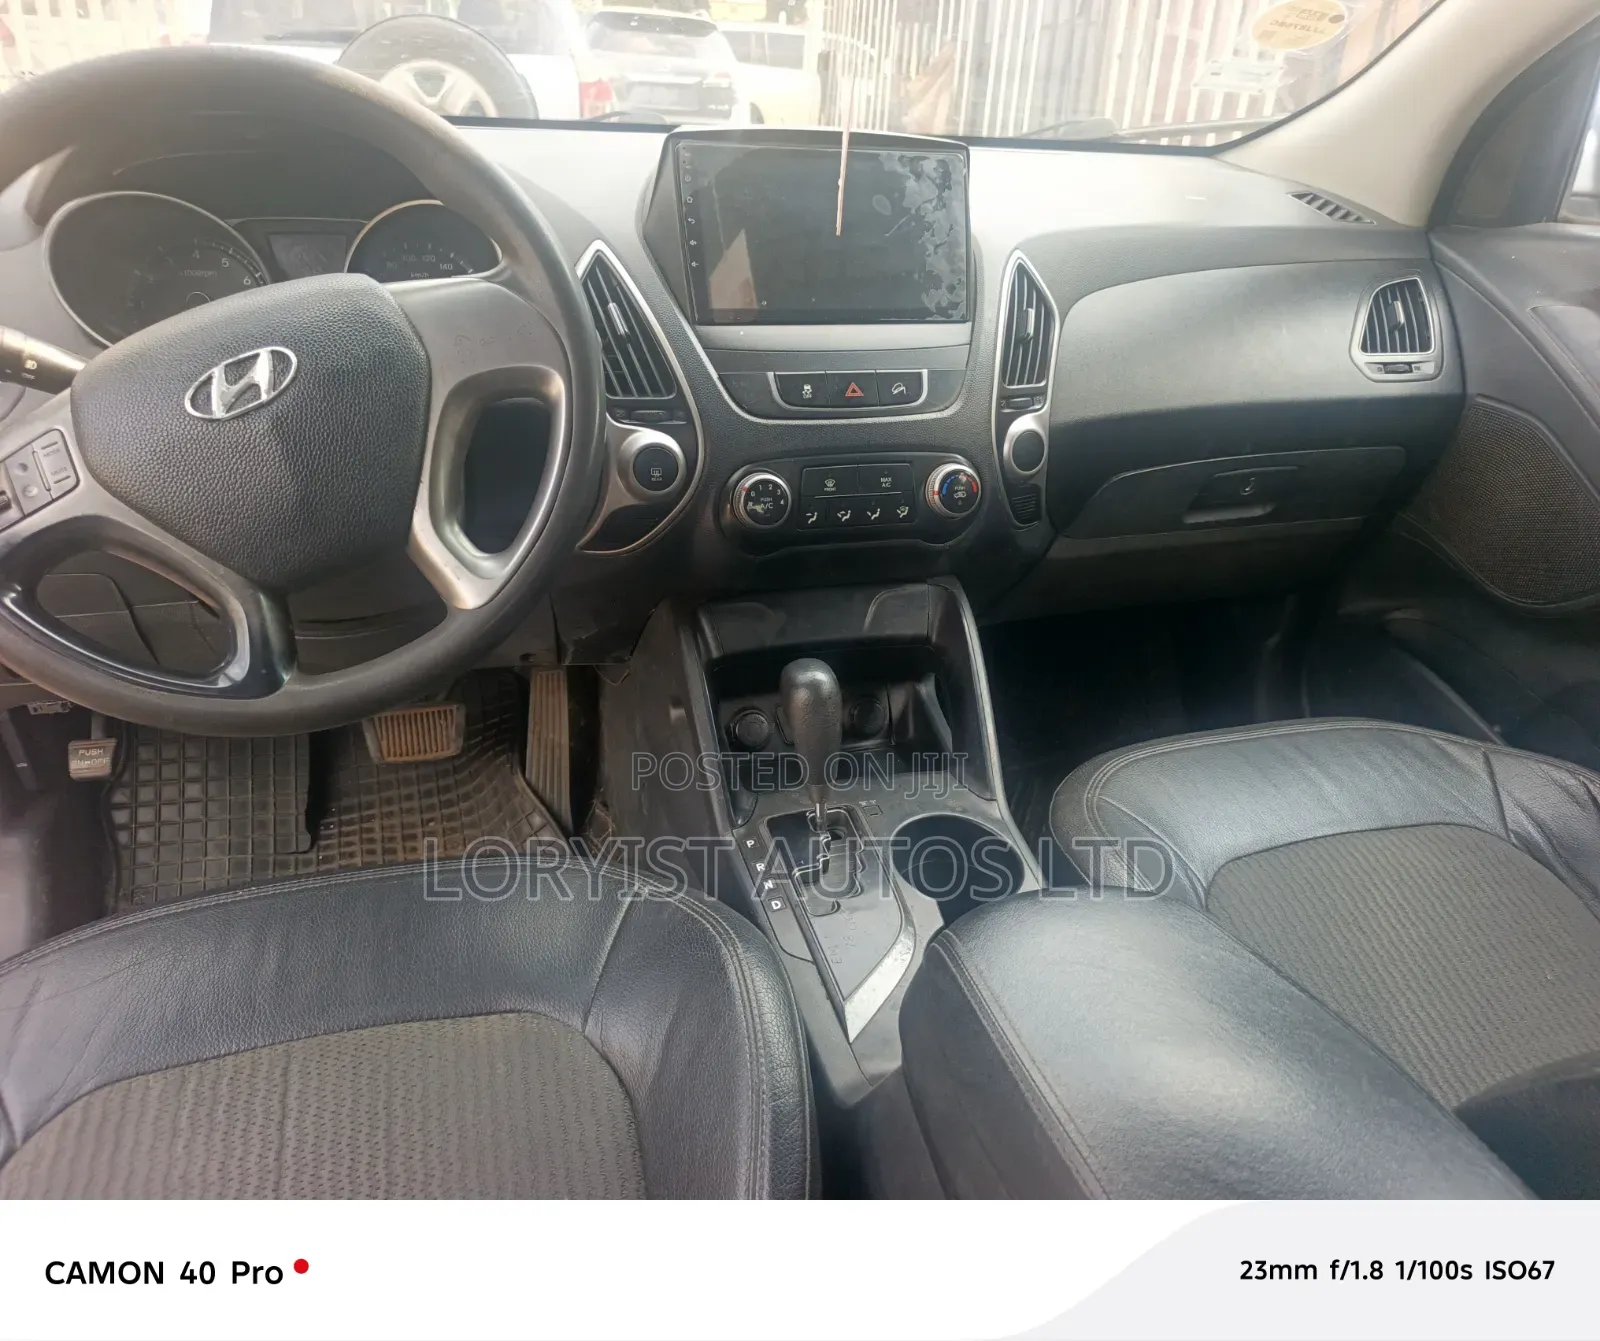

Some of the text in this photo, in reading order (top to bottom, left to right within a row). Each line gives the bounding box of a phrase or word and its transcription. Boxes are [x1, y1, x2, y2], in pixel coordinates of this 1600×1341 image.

[221, 258, 229, 267] 5
[422, 254, 436, 262] 120
[243, 276, 251, 285] 6
[78, 748, 104, 756] PUSH
[746, 840, 755, 848] P
[756, 863, 765, 872] R
[763, 880, 773, 890] N
[771, 901, 781, 910] D
